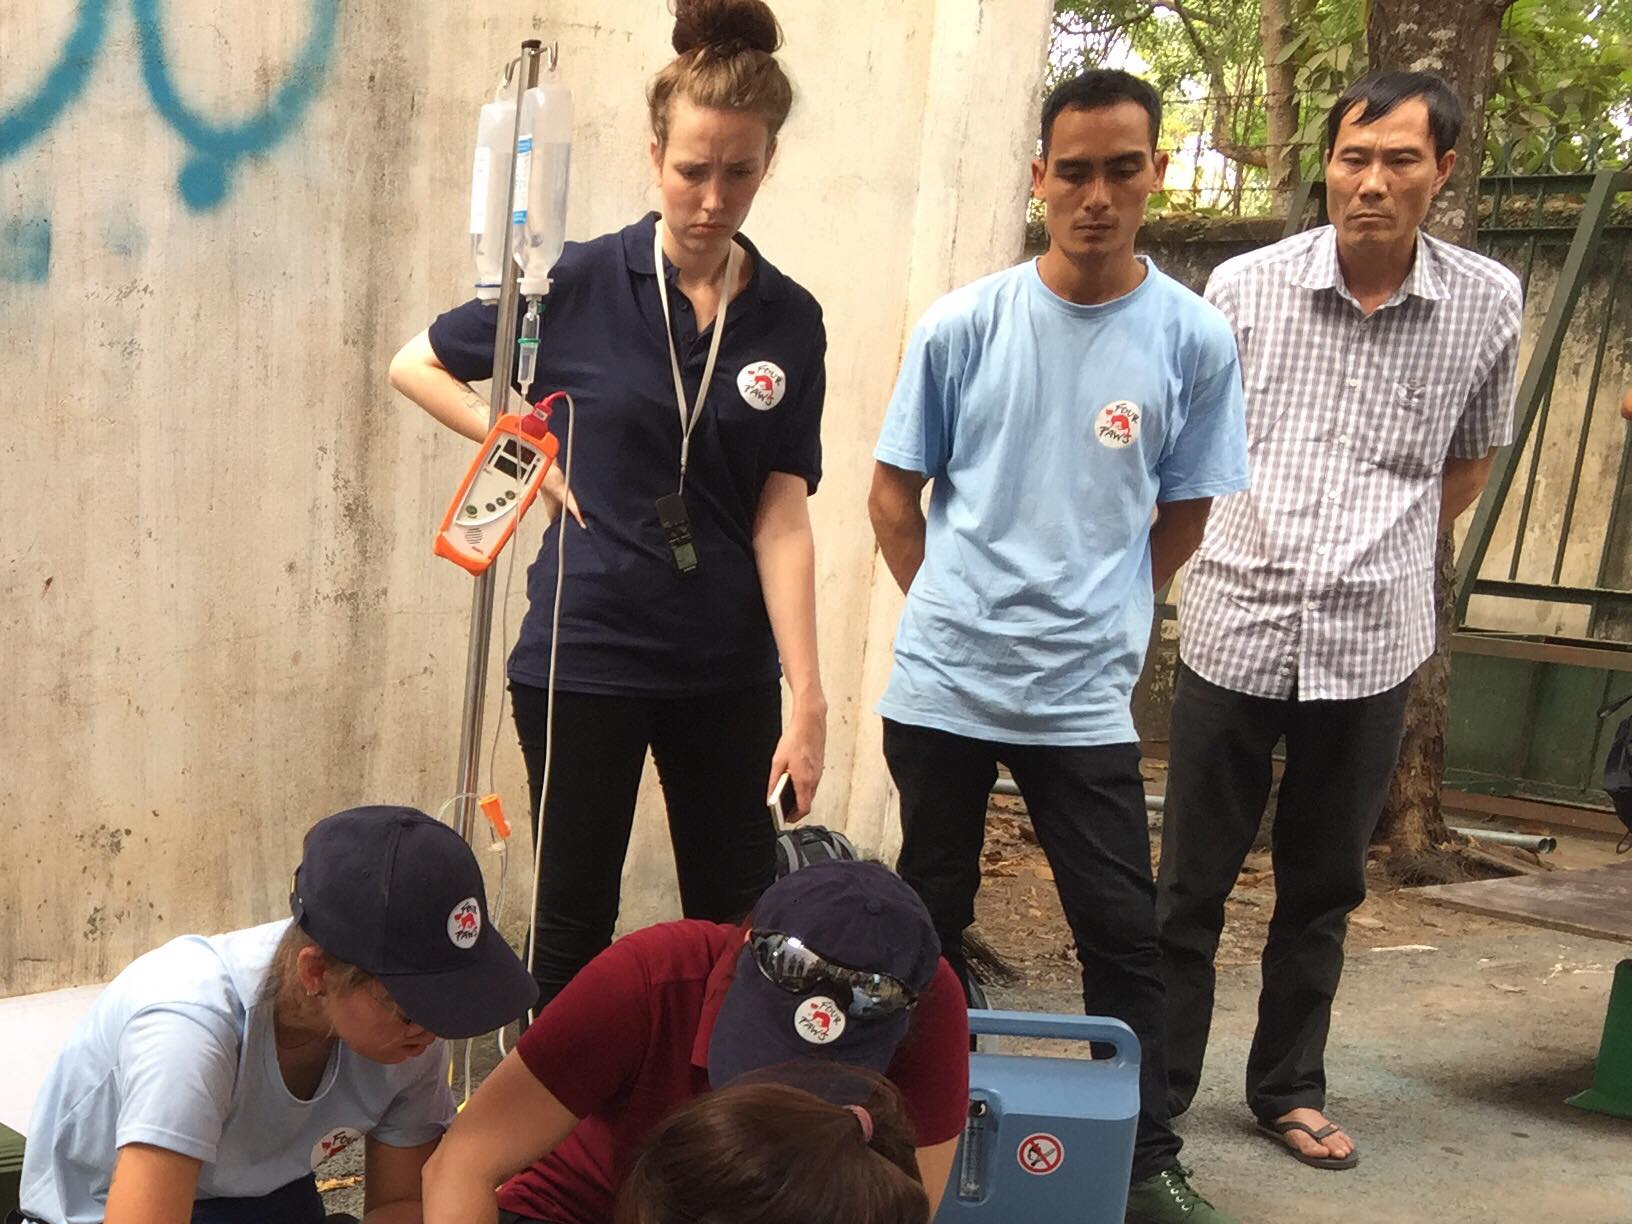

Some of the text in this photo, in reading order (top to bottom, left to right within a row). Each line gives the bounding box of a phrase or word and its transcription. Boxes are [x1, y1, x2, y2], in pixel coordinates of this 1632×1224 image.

[757, 364, 782, 387] FOUR
[744, 384, 774, 407] PAWS
[1114, 402, 1140, 424] FOUR
[1099, 425, 1132, 444] PAWS
[819, 1001, 842, 1026] FOUR
[798, 1015, 829, 1041] PAWS
